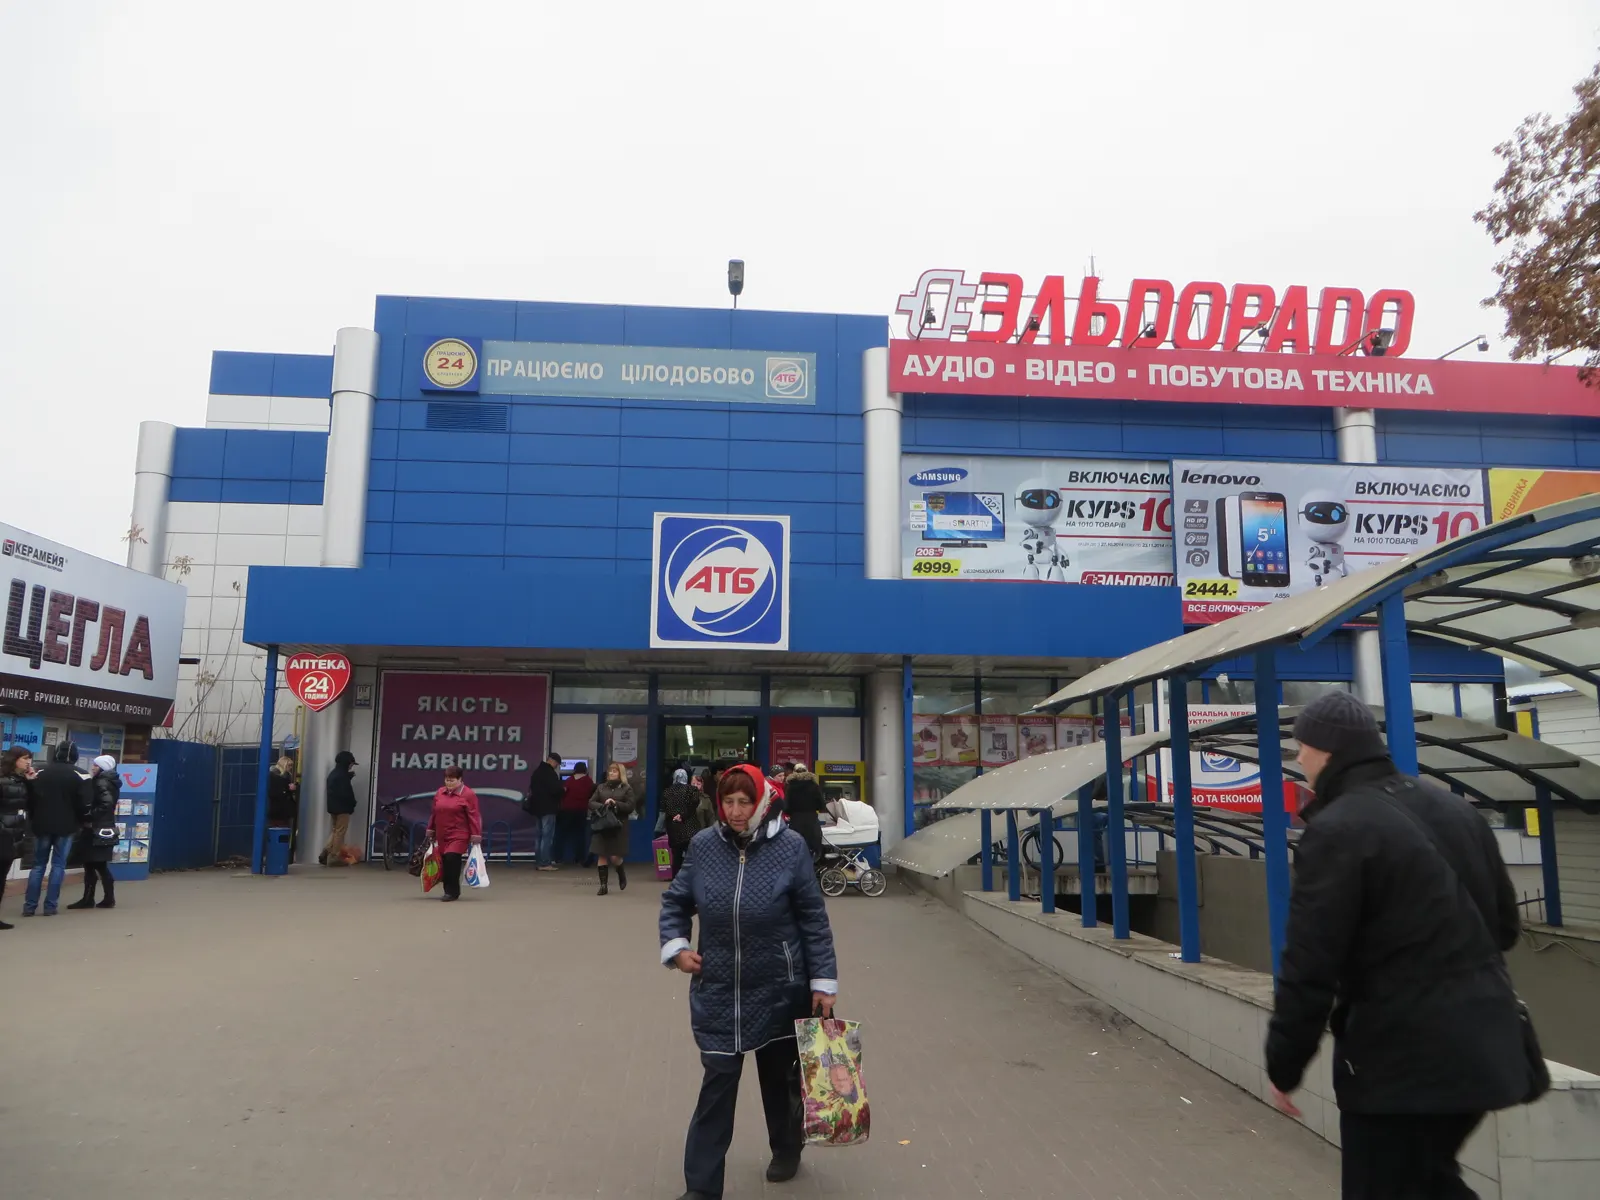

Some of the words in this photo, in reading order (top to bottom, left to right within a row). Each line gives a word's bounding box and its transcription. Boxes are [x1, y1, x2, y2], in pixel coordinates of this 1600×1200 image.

[437, 357, 464, 370] 24
[487, 358, 604, 382] ПРАЦЮЄМО
[620, 363, 755, 387] ЦІЛОДОБОВО
[774, 373, 797, 384] АТБ
[902, 354, 995, 382] АУДІО
[1025, 358, 1116, 387] ВІДЕО
[1148, 363, 1304, 391] ПОБУТОВА
[1312, 369, 1434, 395] ТЕХНІКА
[916, 472, 961, 481] SAMSUNG
[1181, 469, 1261, 486] lenovo
[1355, 481, 1471, 498] ВКЛЮЧАЄМО
[1192, 500, 1200, 508] 4
[1500, 478, 1528, 520] НОВИНКА
[952, 519, 980, 527] SMART
[1432, 511, 1480, 545] 10
[1353, 536, 1365, 544] НА
[1385, 537, 1419, 546] ТОВАРІВ
[15, 541, 65, 568] КЕРАМЕЙЯ
[916, 548, 935, 556] 208
[913, 561, 959, 574] 4999.-
[685, 566, 759, 595] АТБ
[1186, 582, 1237, 596] 2444.-
[1187, 604, 1207, 613] ВСЕ
[1208, 604, 1264, 613] ВКЛЮЧЕНО
[3, 577, 154, 681] ЦЕГЛА
[289, 659, 347, 670] АПТЕКА
[304, 676, 329, 693] 24
[124, 706, 152, 716] ПРОЕКТИ
[417, 695, 509, 714] ЯКІСТЬ
[1187, 710, 1229, 718] ІОНАЛЬНА
[401, 723, 522, 742] ГАРАНТІЯ
[391, 752, 529, 771] НАЯВНІСТЬ
[1206, 794, 1219, 803] ТА
[1220, 794, 1263, 803] ЕКОНОМ
